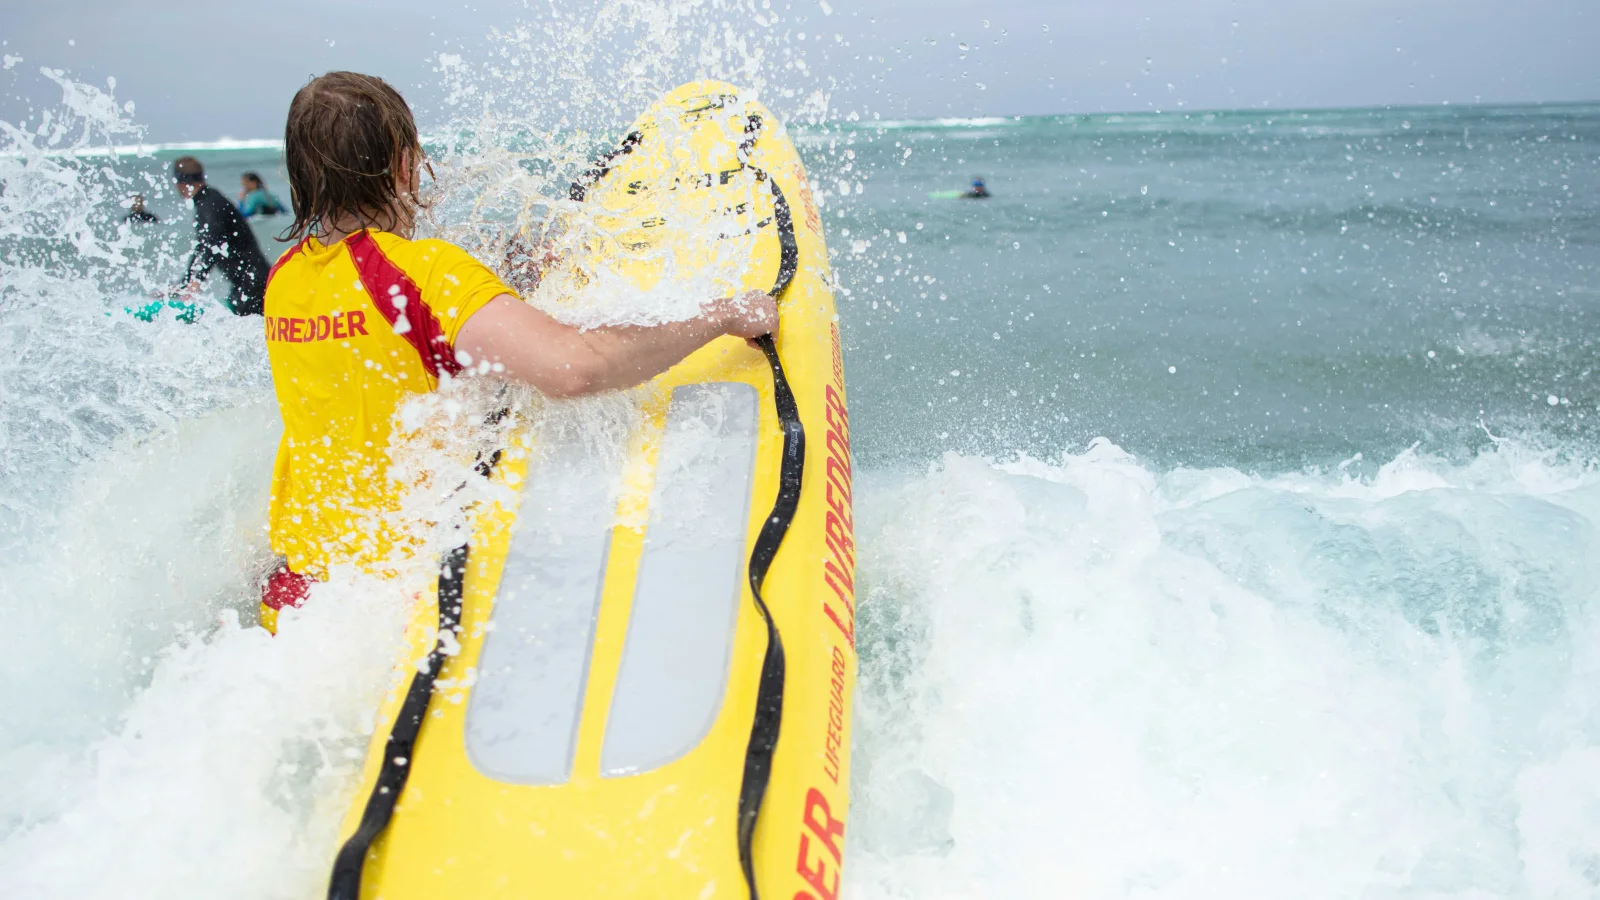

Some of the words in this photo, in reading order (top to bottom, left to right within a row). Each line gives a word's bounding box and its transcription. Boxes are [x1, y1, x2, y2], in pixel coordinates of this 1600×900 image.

[823, 384, 855, 650] LIVREDDER
[792, 787, 844, 900] ER
[824, 645, 846, 785] LIFEGUARD
